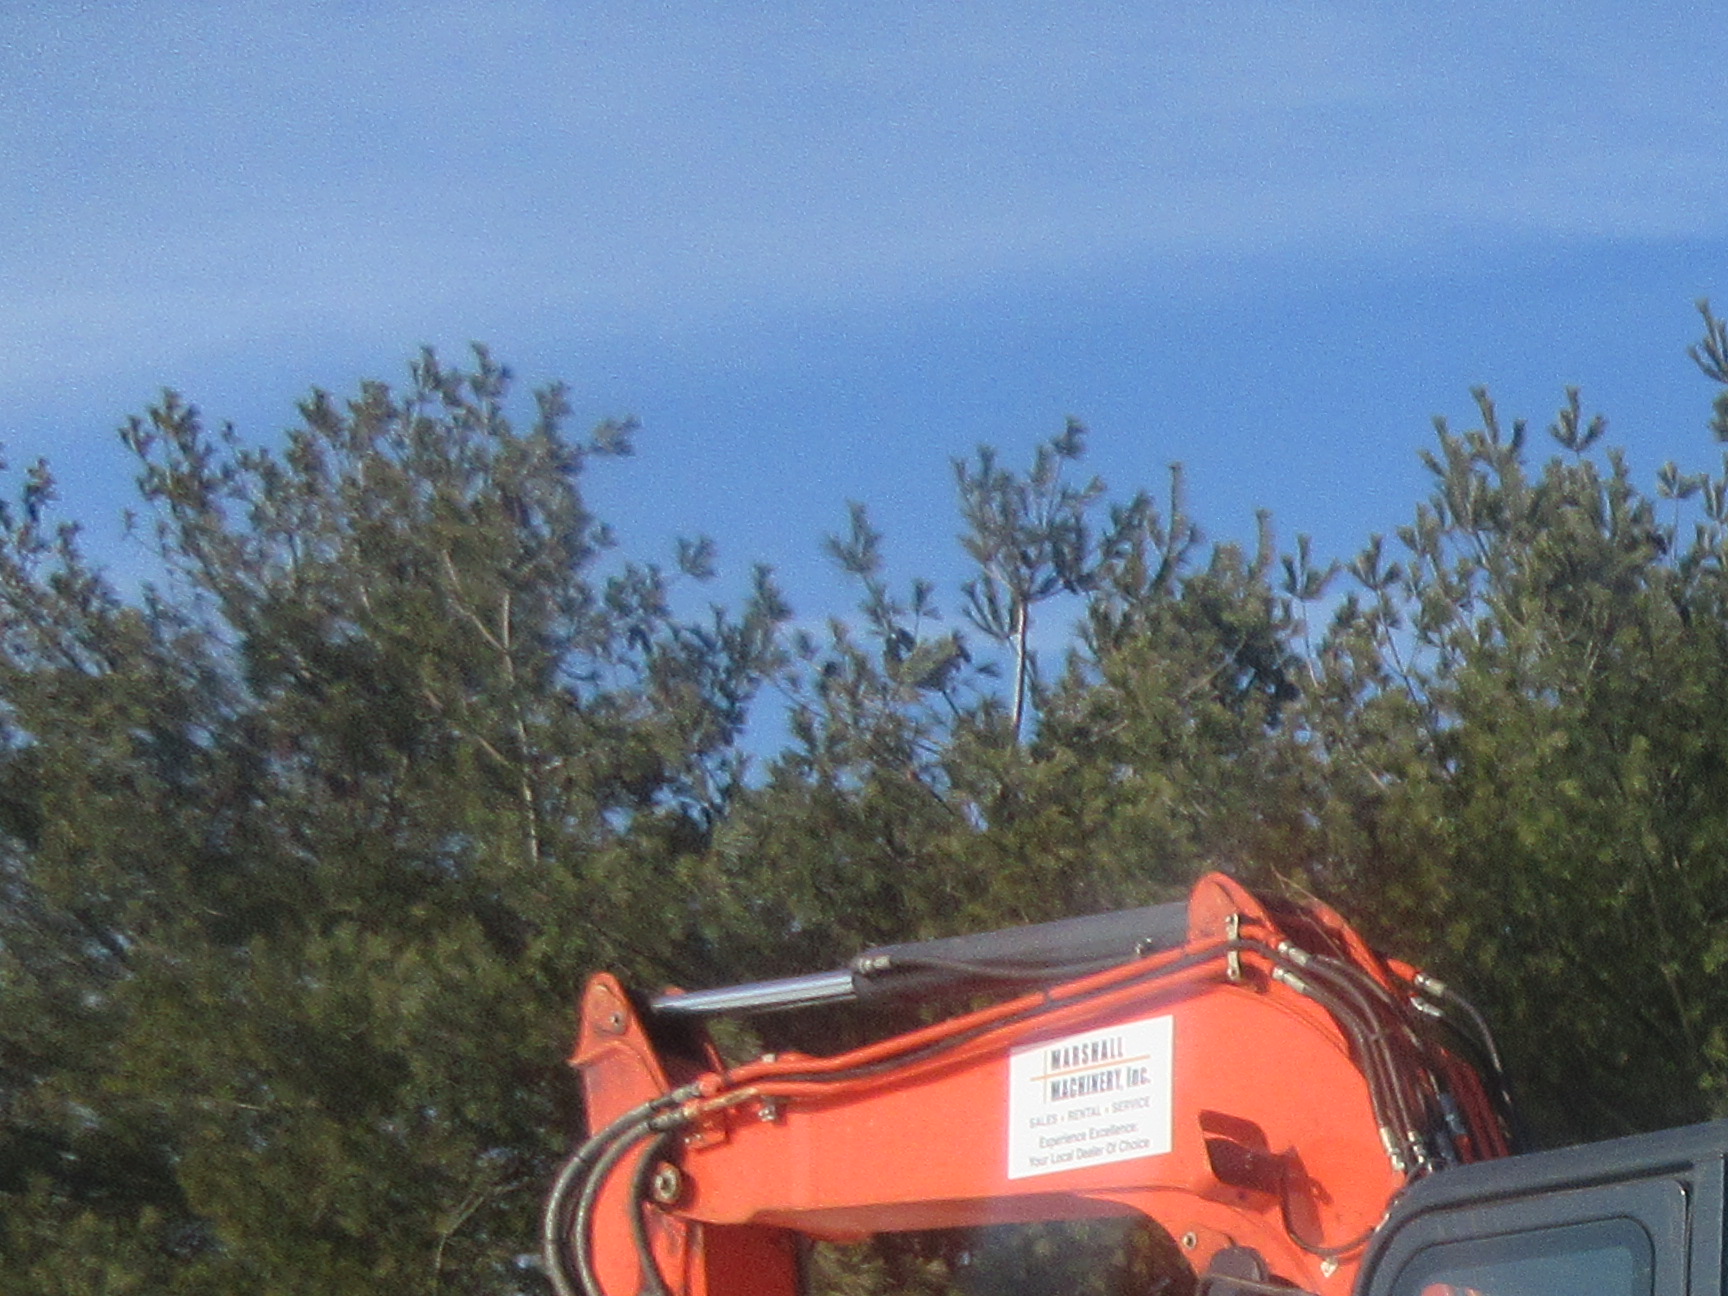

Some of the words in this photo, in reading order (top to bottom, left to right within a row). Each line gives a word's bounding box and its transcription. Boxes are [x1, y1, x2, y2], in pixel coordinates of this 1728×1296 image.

[1051, 1036, 1123, 1071] MARSHALL
[1051, 1068, 1123, 1102] MACHINERY,
[1127, 1066, 1151, 1088] Inc.
[1029, 1113, 1058, 1129] SALES
[1067, 1105, 1101, 1121] RENTAL
[1111, 1096, 1150, 1113] SERVICE
[1029, 1155, 1049, 1167] Your
[1050, 1149, 1074, 1164] Local
[1076, 1146, 1104, 1160] Dealer
[1118, 1137, 1150, 1153] Choice
[1039, 1131, 1087, 1149] Experience
